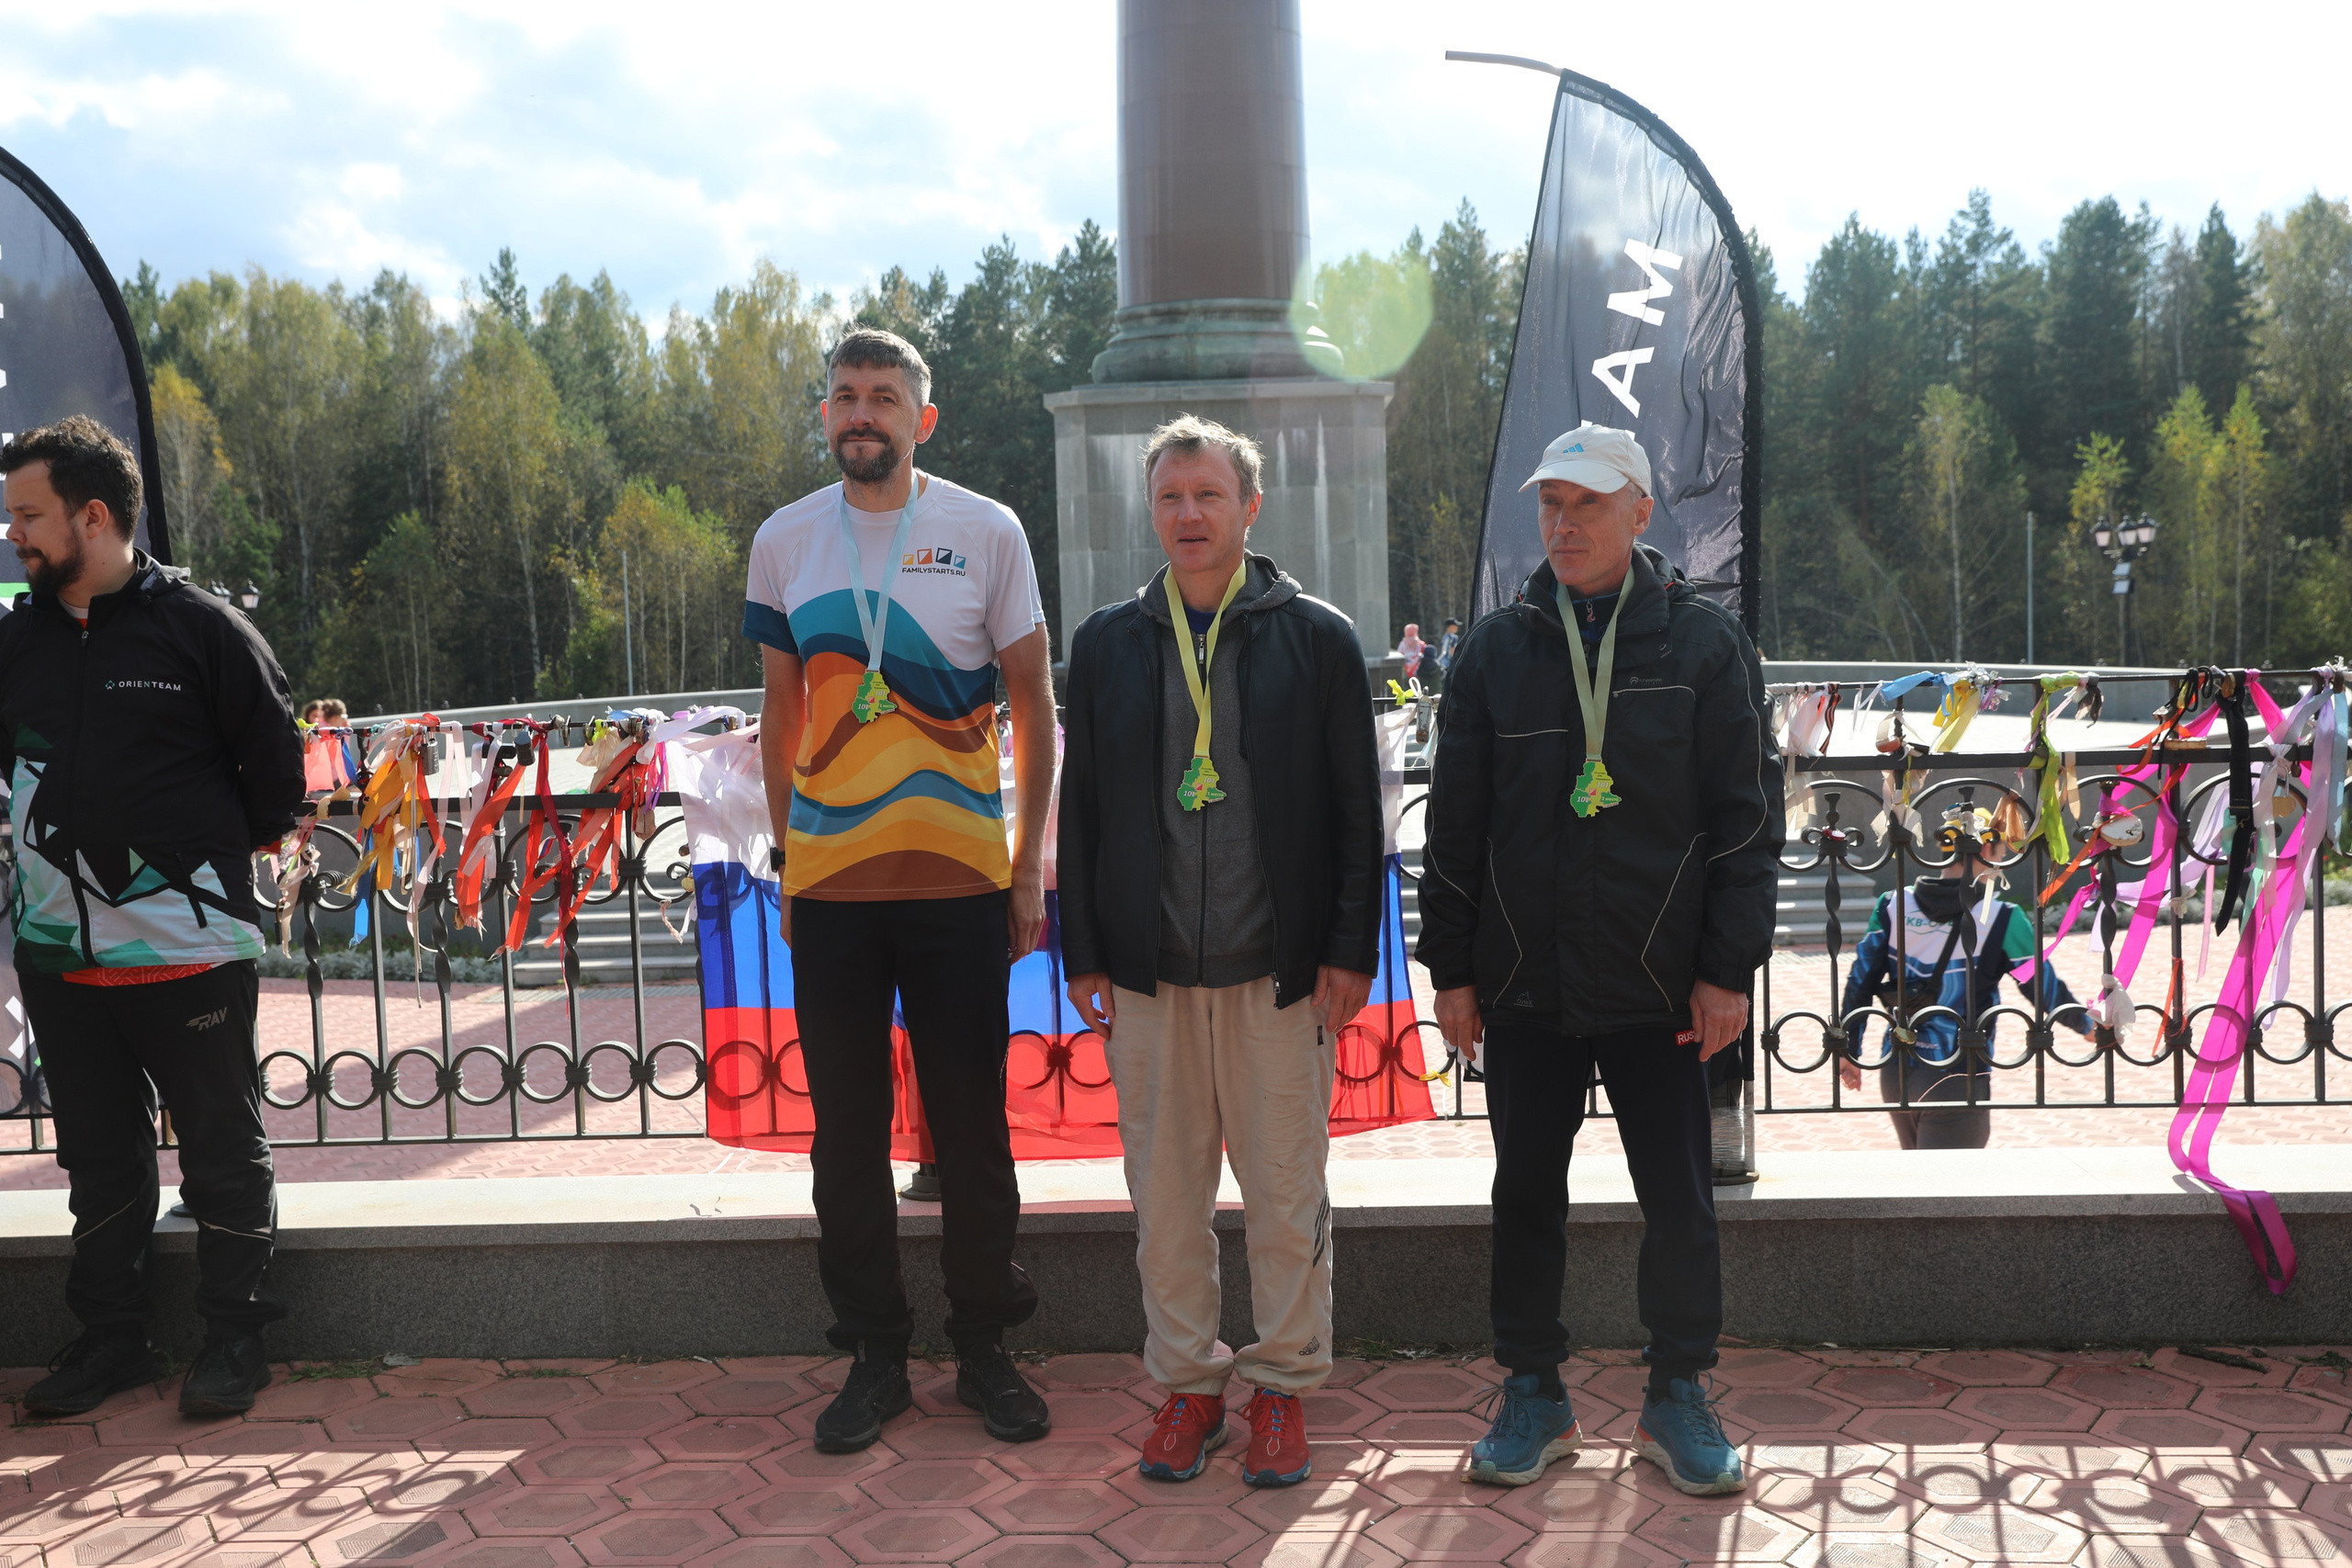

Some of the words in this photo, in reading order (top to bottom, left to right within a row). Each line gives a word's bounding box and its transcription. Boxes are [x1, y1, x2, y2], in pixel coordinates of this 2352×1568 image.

[1580, 238, 1684, 441] AM
[901, 567, 967, 577] FAMILYSTARTS.RU
[118, 681, 181, 692] ORIENTEAM
[187, 1006, 228, 1032] RAY
[1677, 1030, 1695, 1044] RUS
